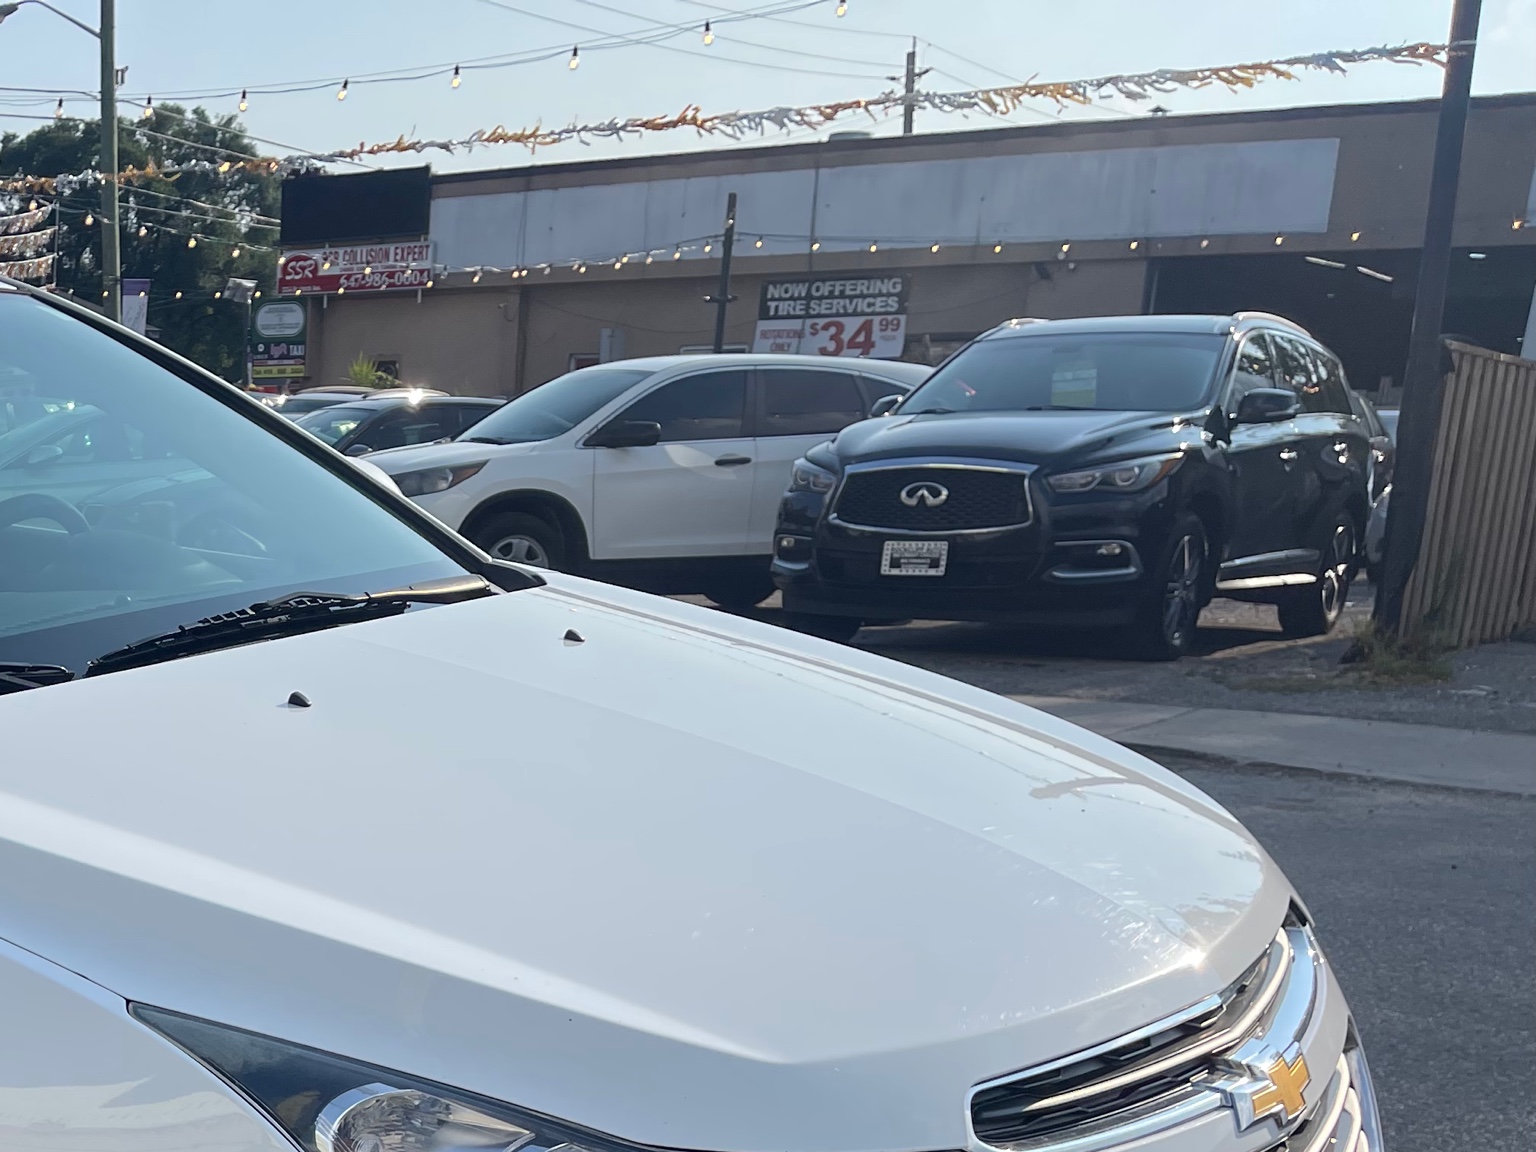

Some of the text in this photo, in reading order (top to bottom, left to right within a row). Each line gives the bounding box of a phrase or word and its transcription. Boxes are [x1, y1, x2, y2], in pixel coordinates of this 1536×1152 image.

[342, 246, 390, 265] COLLISION
[394, 244, 431, 262] EXPERT
[285, 259, 316, 280] SSR
[767, 278, 903, 299] NOW OFFERING
[768, 296, 900, 316] TIRE SERVICES
[879, 317, 901, 332] 99
